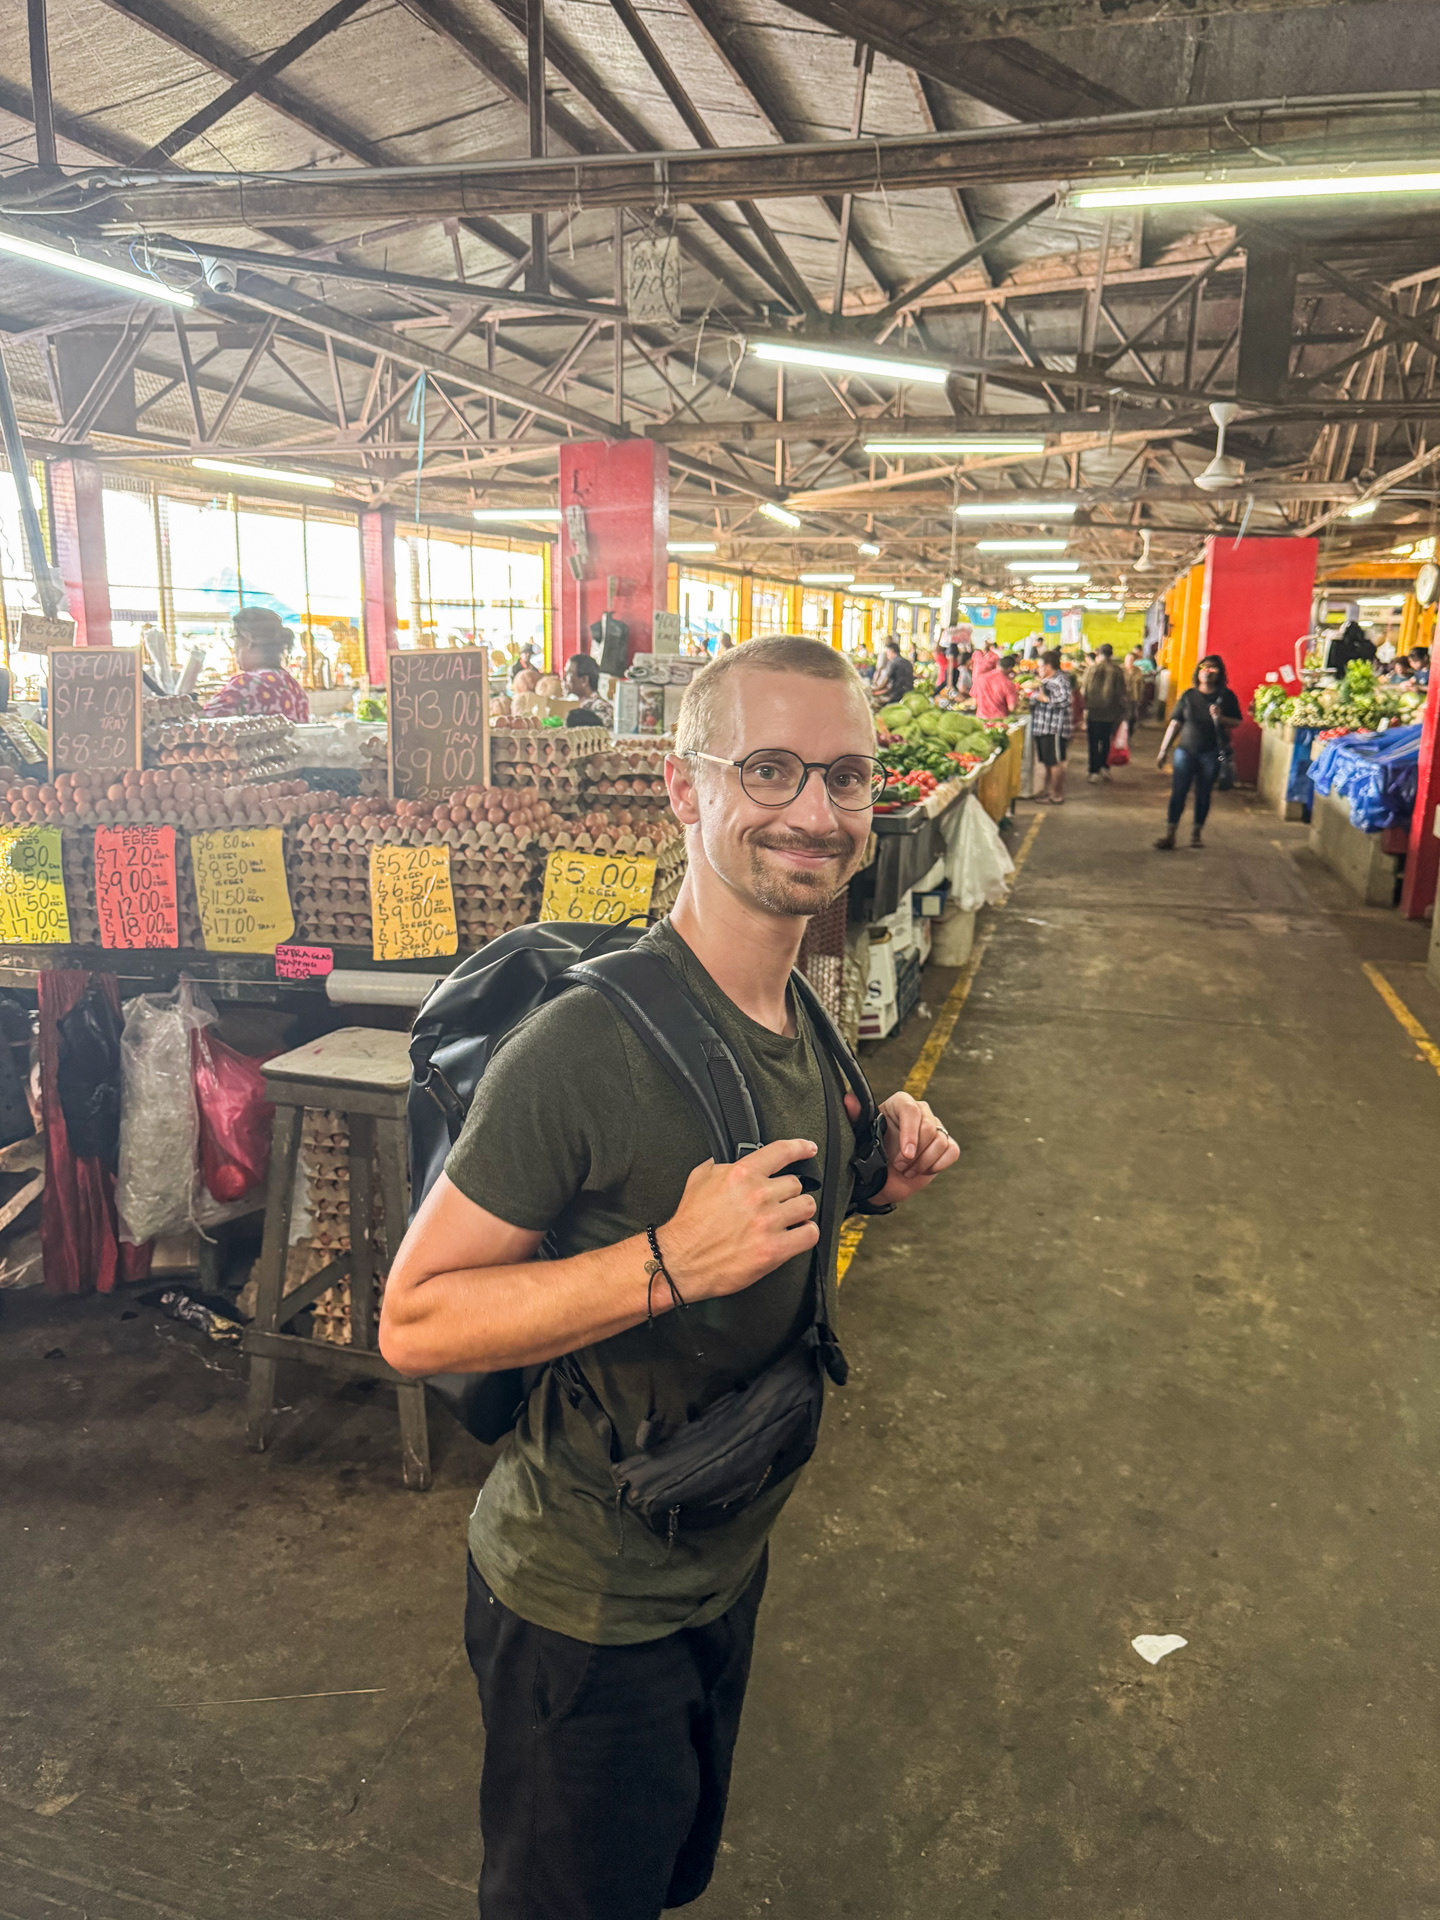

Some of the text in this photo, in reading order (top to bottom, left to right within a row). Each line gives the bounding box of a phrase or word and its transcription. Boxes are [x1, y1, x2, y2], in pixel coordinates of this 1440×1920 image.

[55, 653, 136, 680] SPECIAL
[392, 655, 481, 685] SPECIAL
[100, 716, 129, 733] TRAY
[441, 728, 479, 750] TRAY
[122, 834, 159, 846] EGGS
